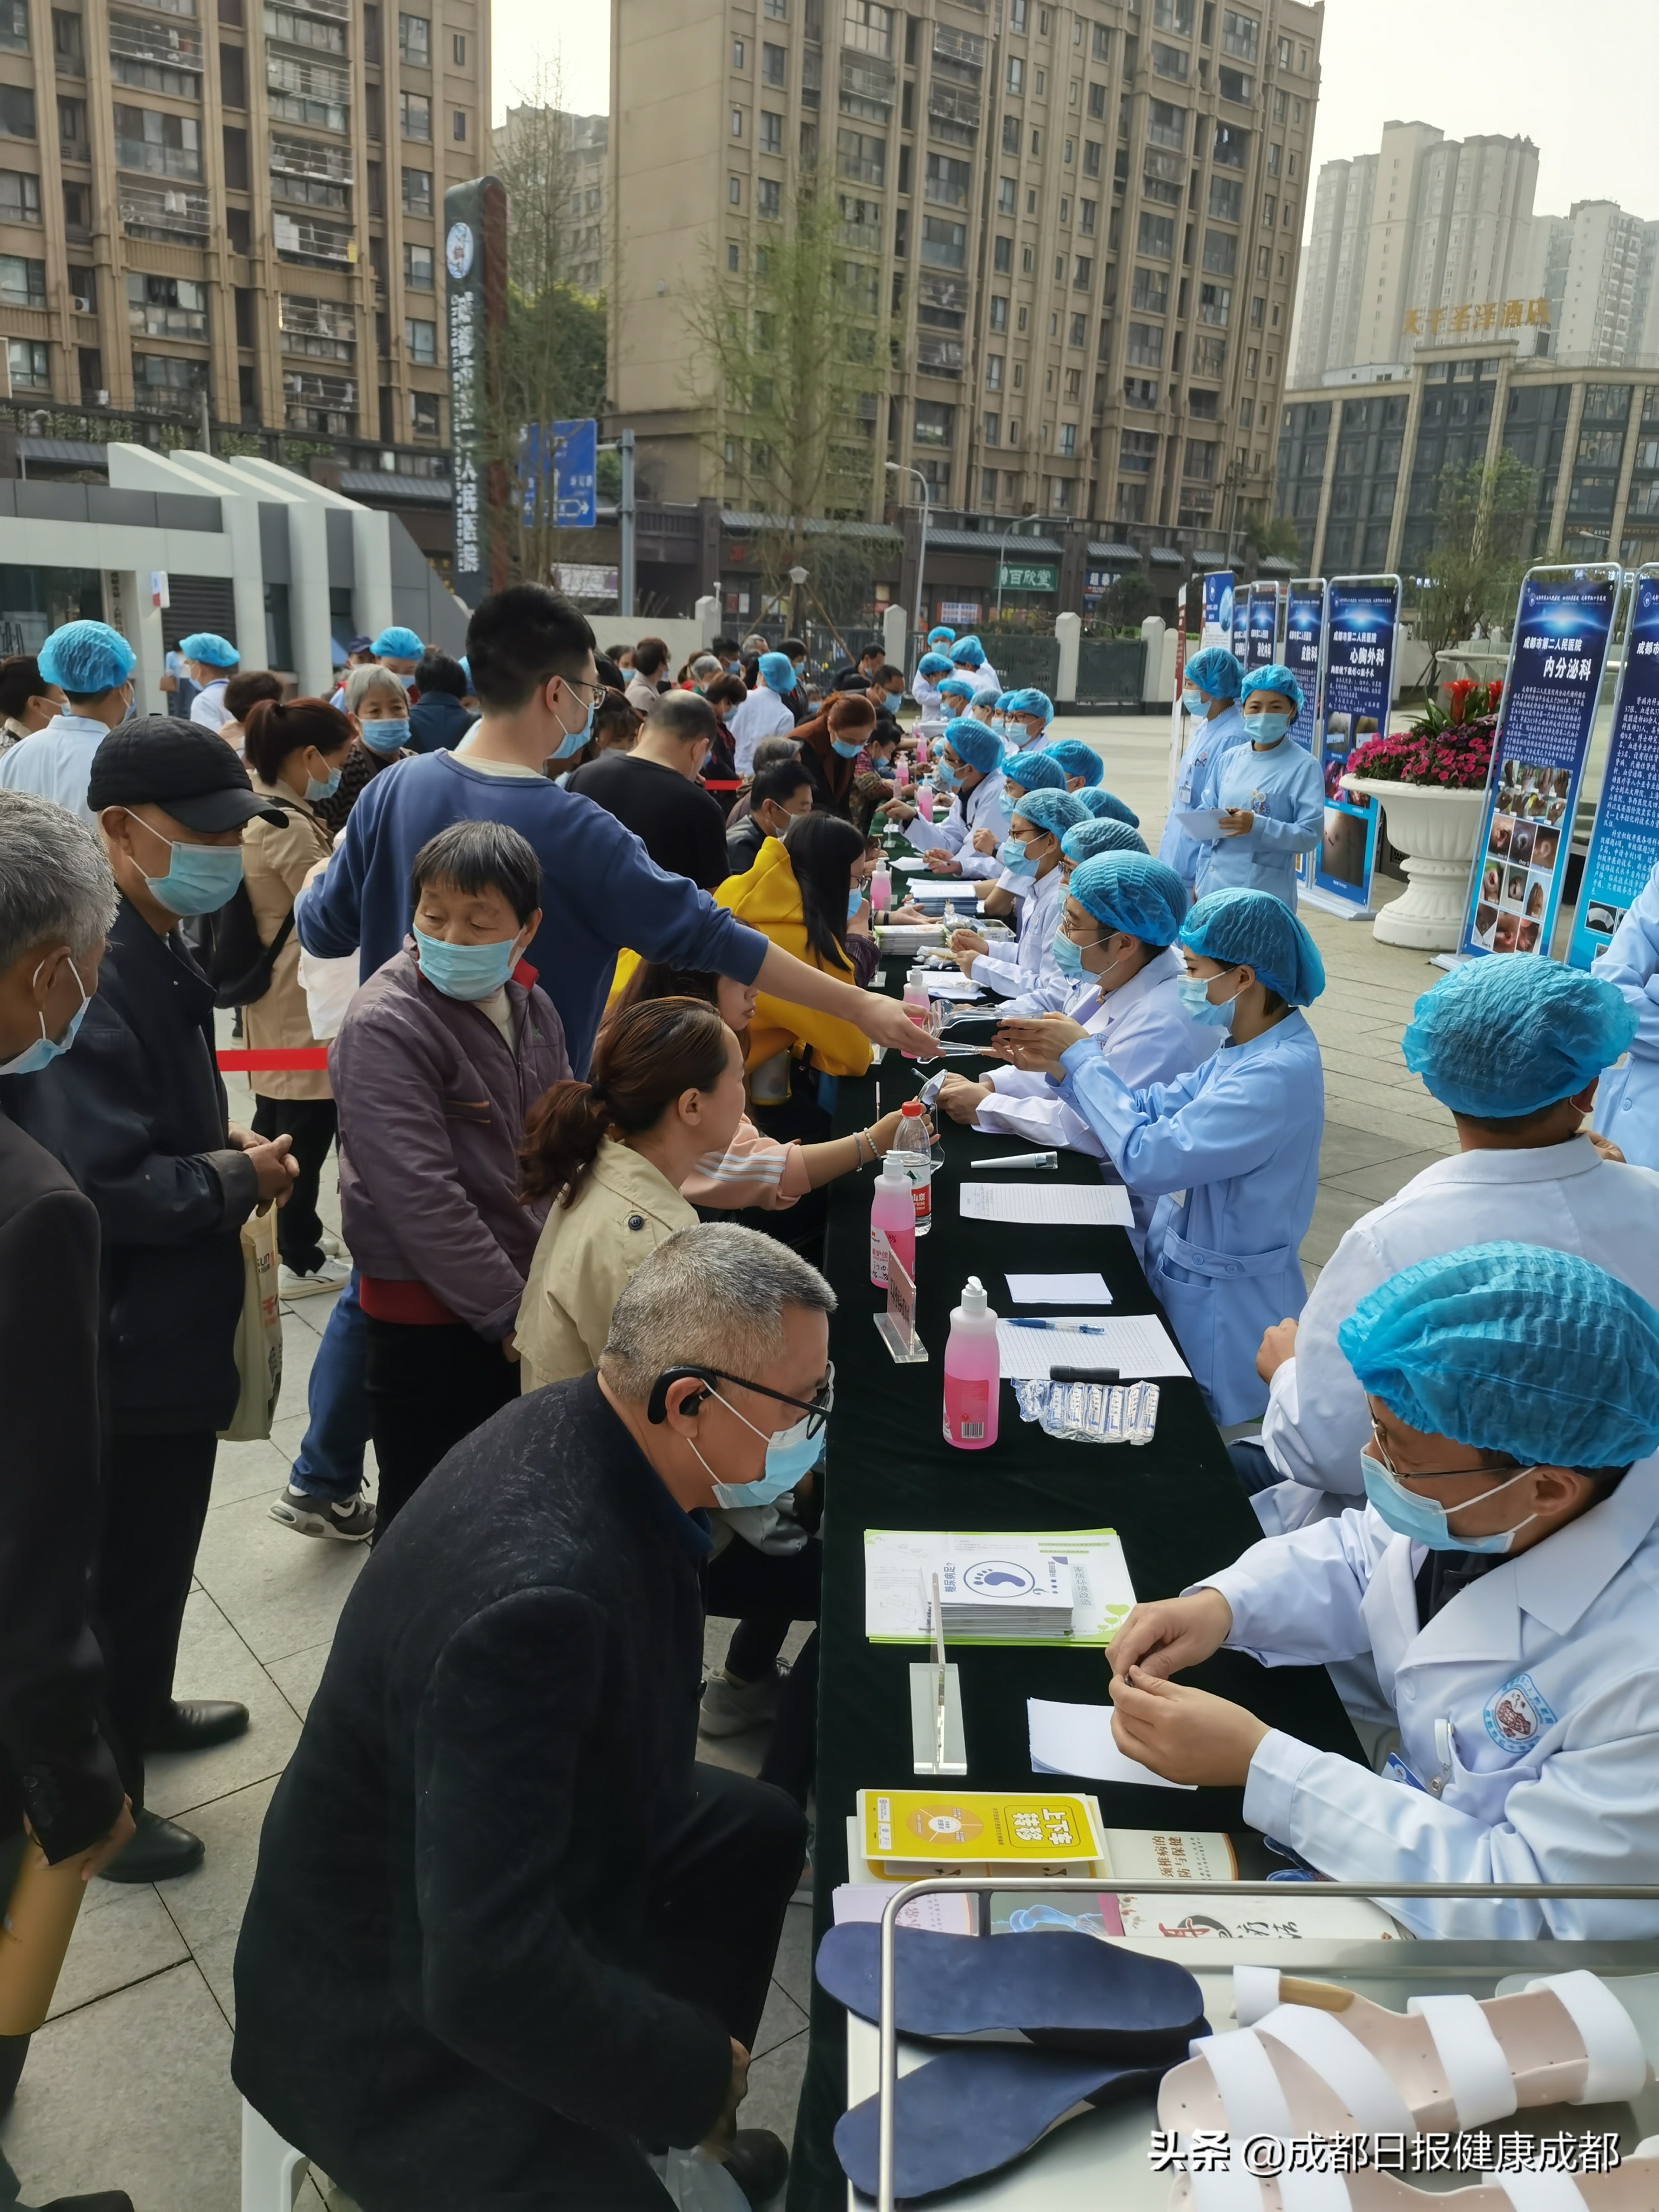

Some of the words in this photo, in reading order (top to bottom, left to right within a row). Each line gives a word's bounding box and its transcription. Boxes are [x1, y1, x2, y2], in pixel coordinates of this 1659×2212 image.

[1009, 569, 1051, 587] 百欣堂
[1333, 630, 1377, 644] 成都市第二人民医院
[1523, 637, 1582, 652] 成都市第二人民医院
[1301, 644, 1318, 663] 皮肤科
[1350, 647, 1385, 667] 心胸外科
[1542, 655, 1593, 682] 内分泌科
[1612, 830, 1659, 847] 科室积极开展各项科
[1073, 1566, 1092, 1606] 家居环境改造
[1011, 1811, 1044, 1842] 转移
[1041, 1808, 1074, 1845] 上下车
[1152, 1836, 1175, 1878] 颈椎病的
[1190, 1837, 1206, 1880] 都市第二人民医院
